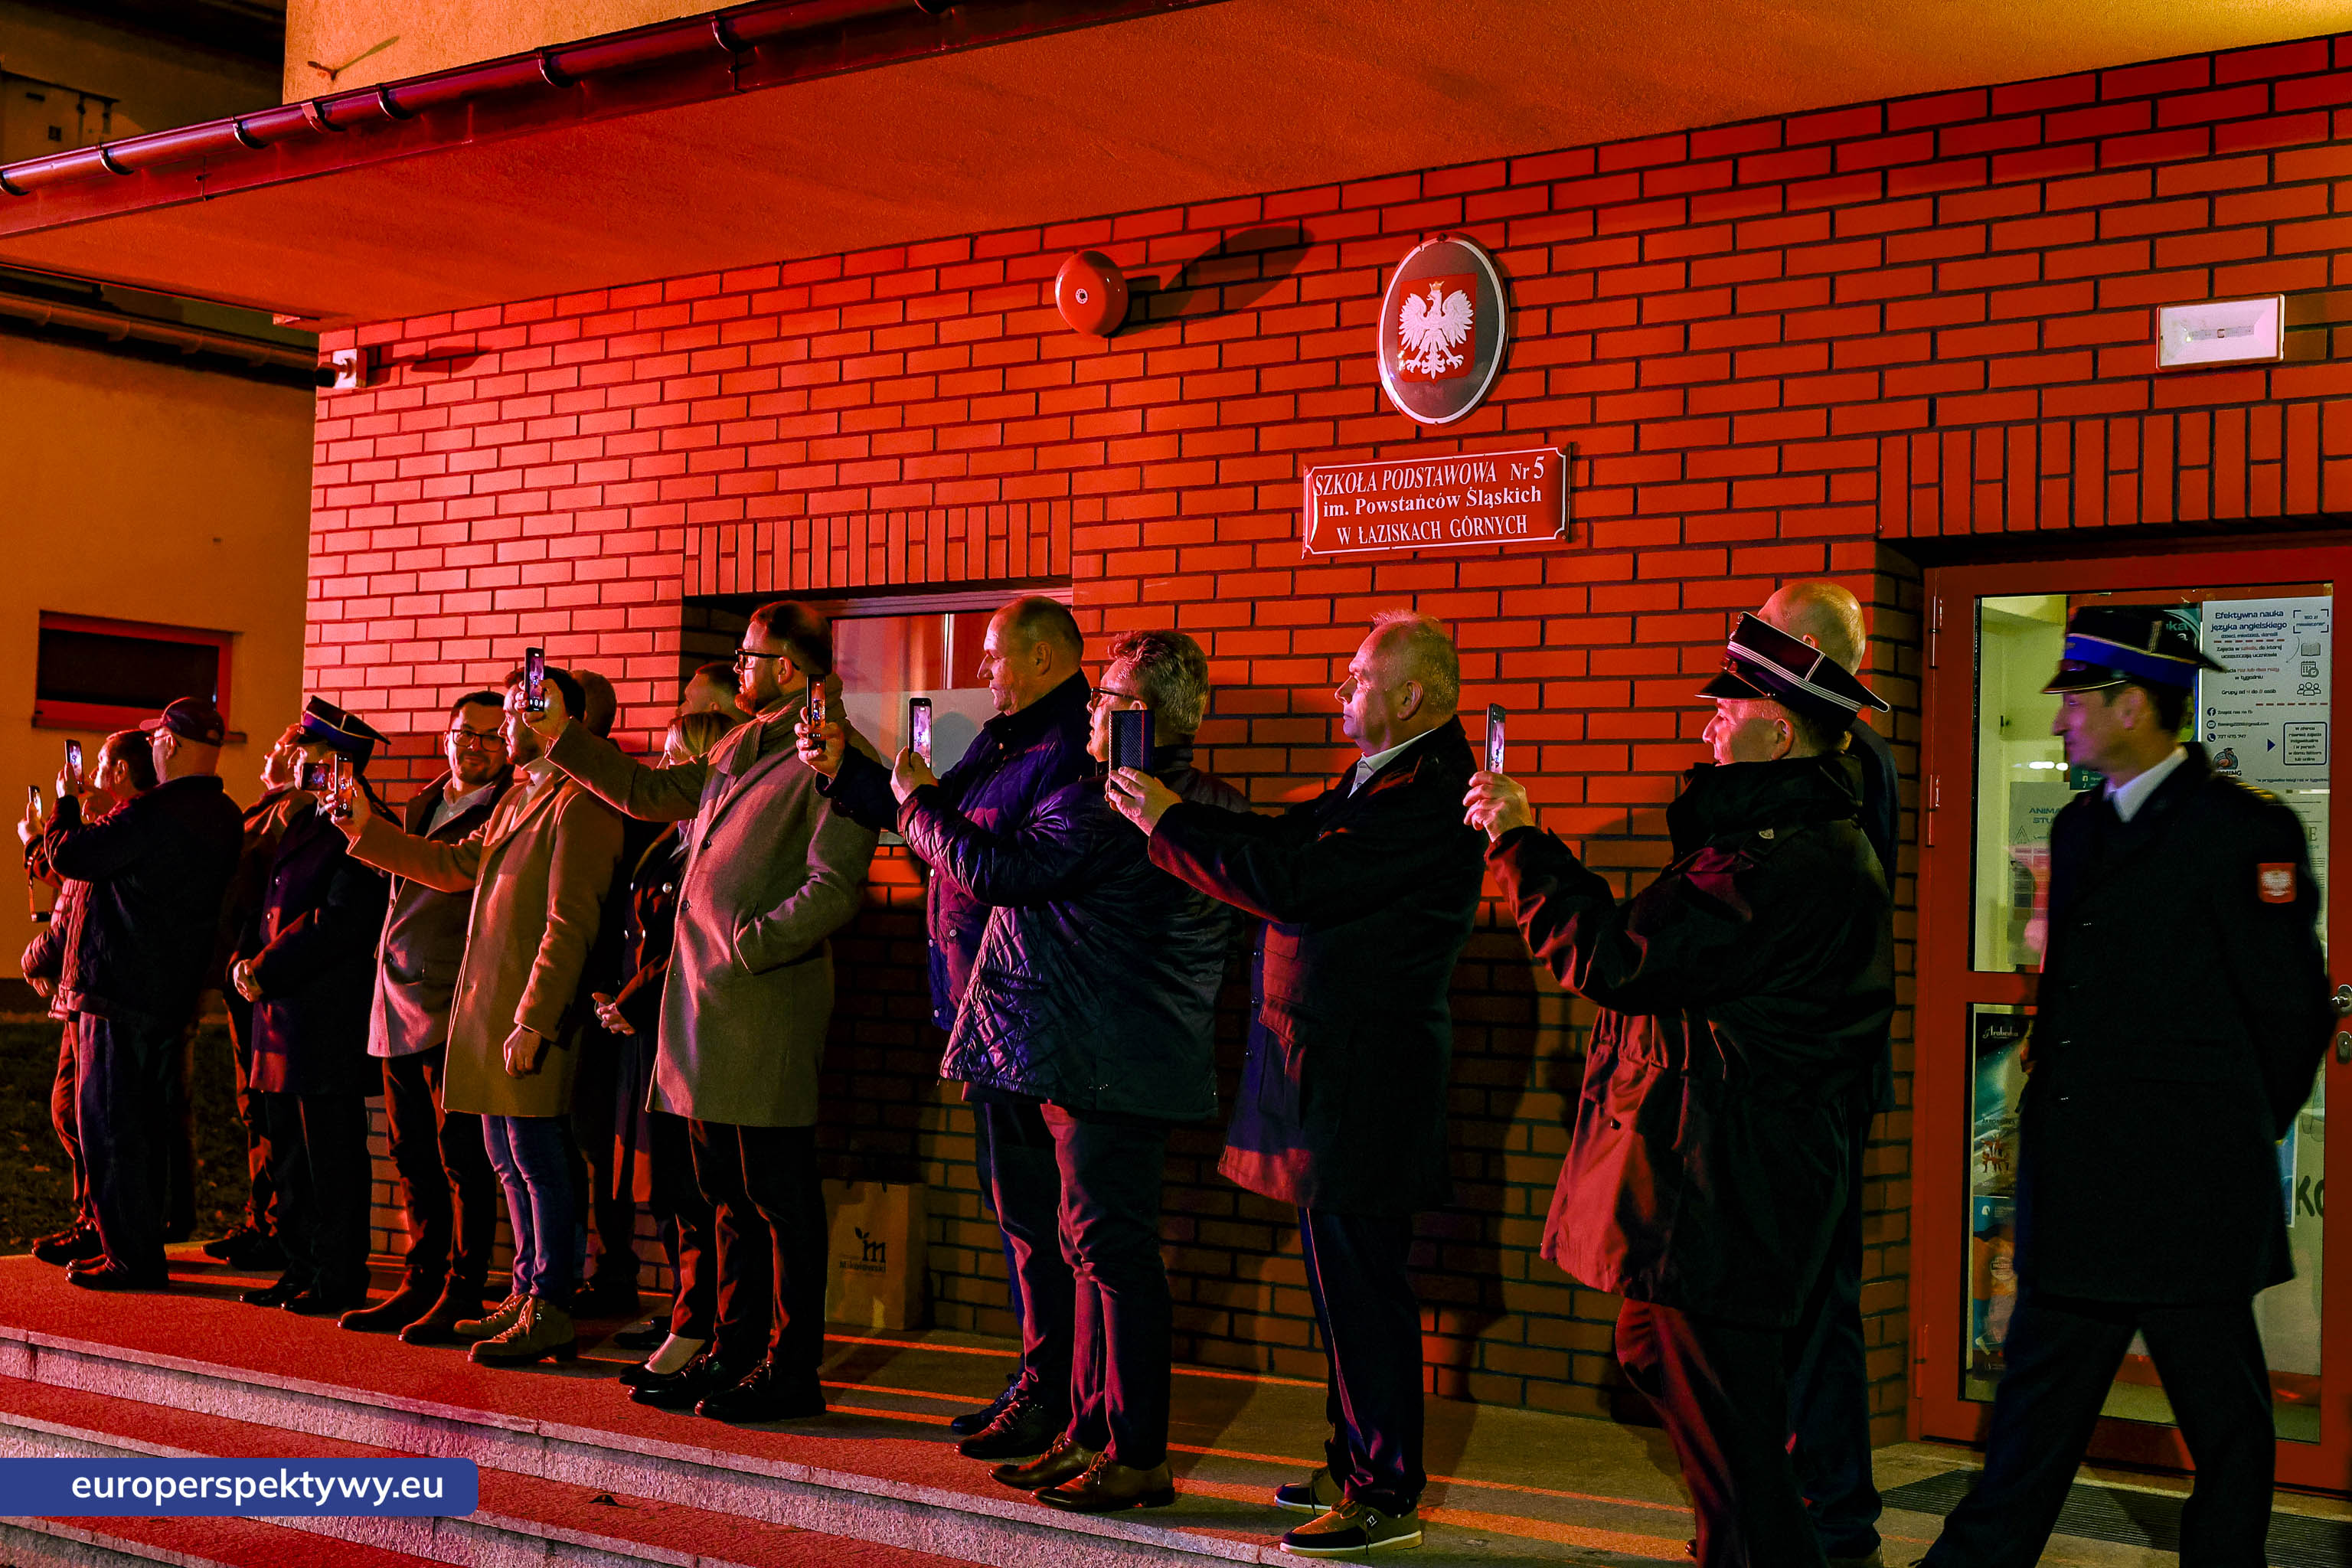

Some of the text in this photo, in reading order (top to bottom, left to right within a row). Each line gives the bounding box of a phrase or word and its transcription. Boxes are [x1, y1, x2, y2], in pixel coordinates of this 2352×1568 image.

[1315, 455, 1544, 497] SZKOŁA PODSTAWOWA Nr 5
[1323, 485, 1541, 518] im. Powstańców Śląskich
[1337, 513, 1527, 545] W ŁAZISKACH GÓRNYCH
[2211, 621, 2288, 632] języka angielskiego
[2215, 610, 2284, 620] Efektywna nauka
